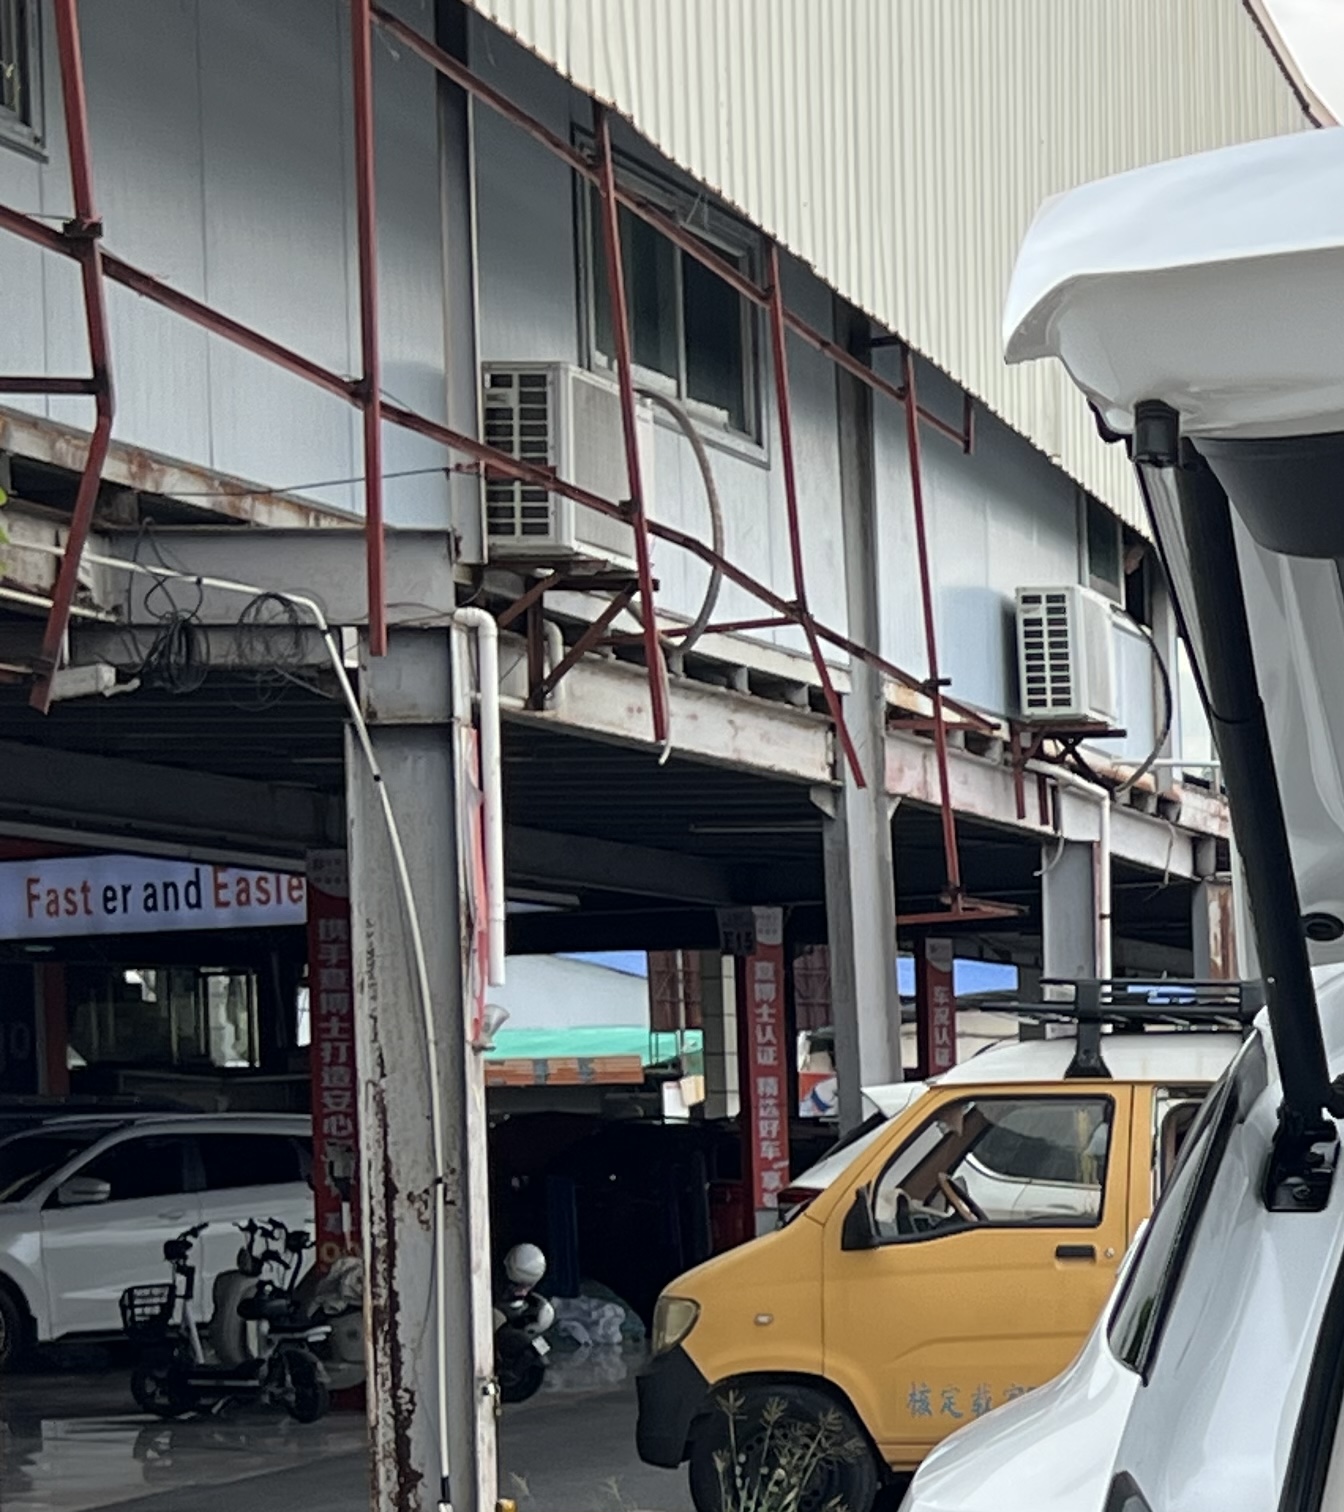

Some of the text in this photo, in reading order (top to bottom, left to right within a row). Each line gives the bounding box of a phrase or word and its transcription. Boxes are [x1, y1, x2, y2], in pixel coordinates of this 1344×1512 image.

[142, 867, 202, 912] and
[906, 1382, 1036, 1419] 核定载
